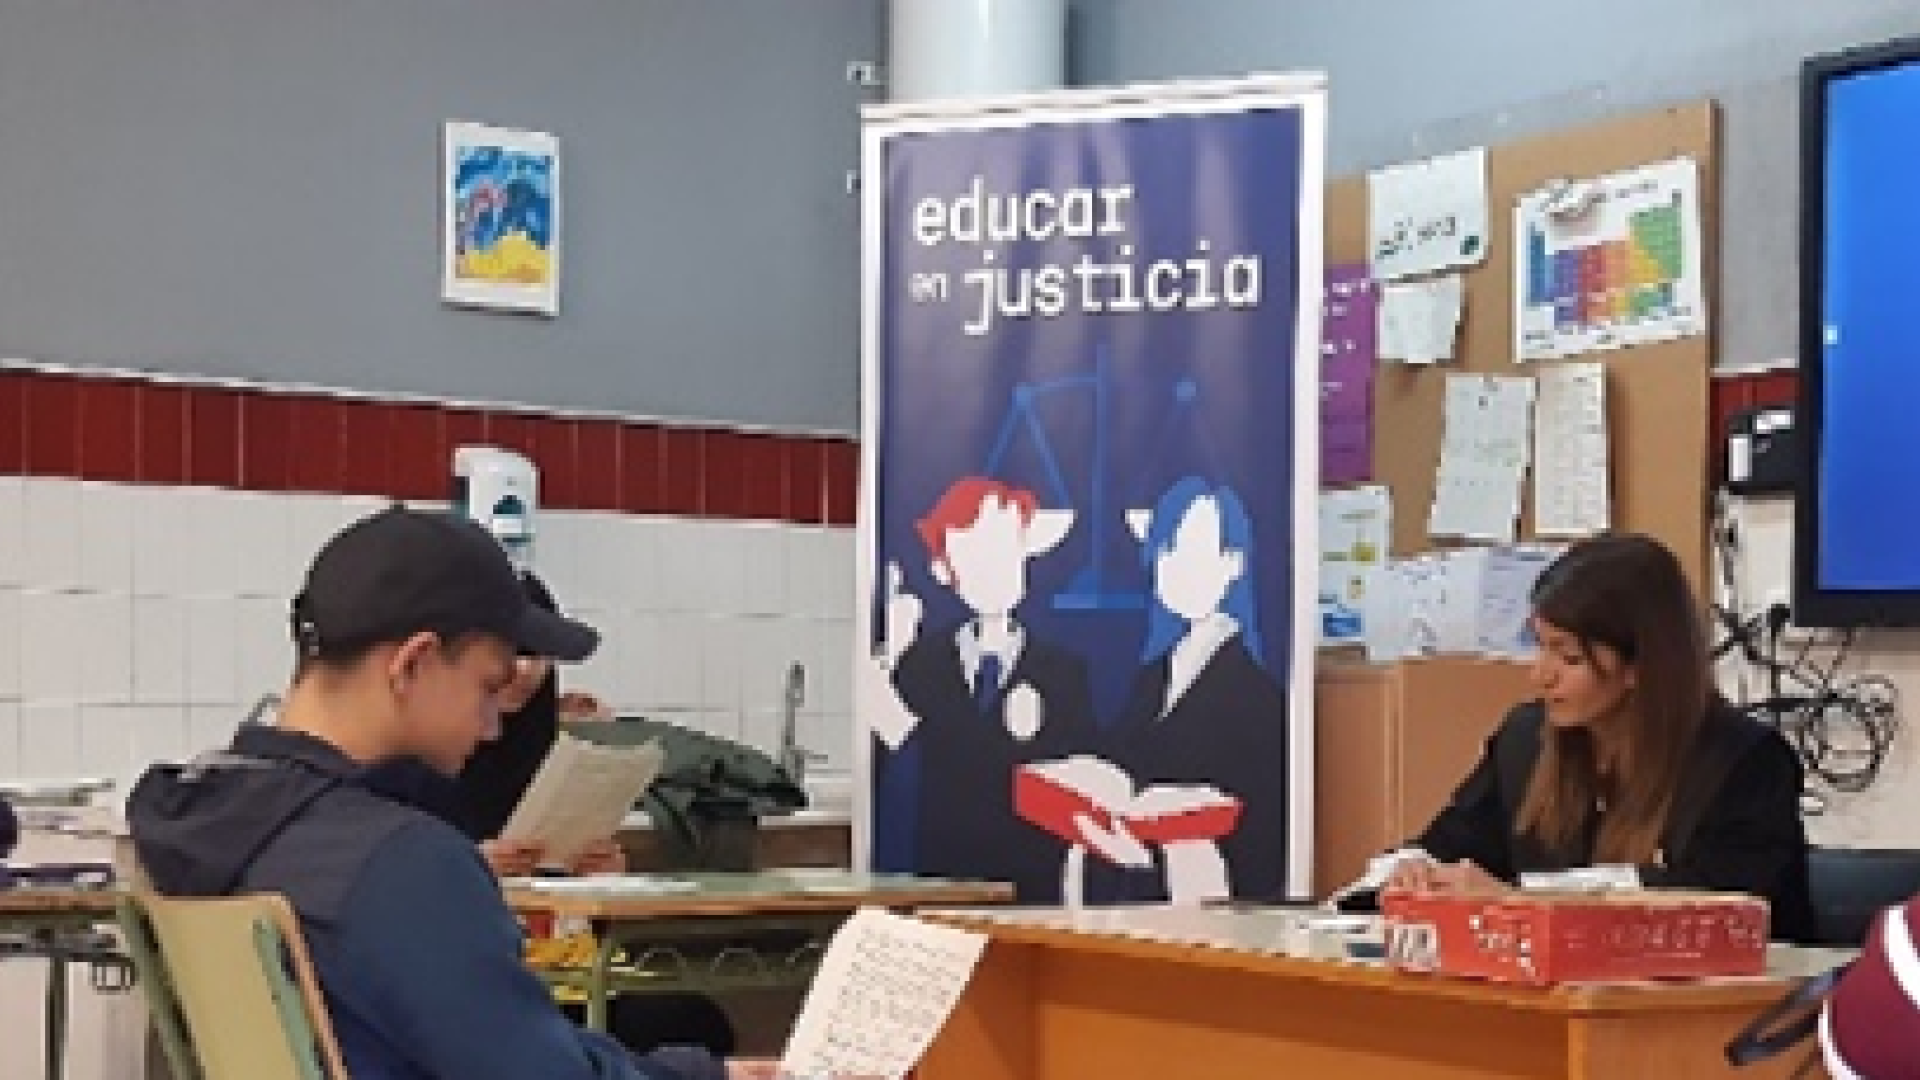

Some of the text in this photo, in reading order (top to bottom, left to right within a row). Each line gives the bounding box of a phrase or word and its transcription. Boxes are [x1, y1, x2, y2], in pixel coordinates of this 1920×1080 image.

[913, 175, 1134, 245] educar
[910, 240, 1262, 336] en justicia
